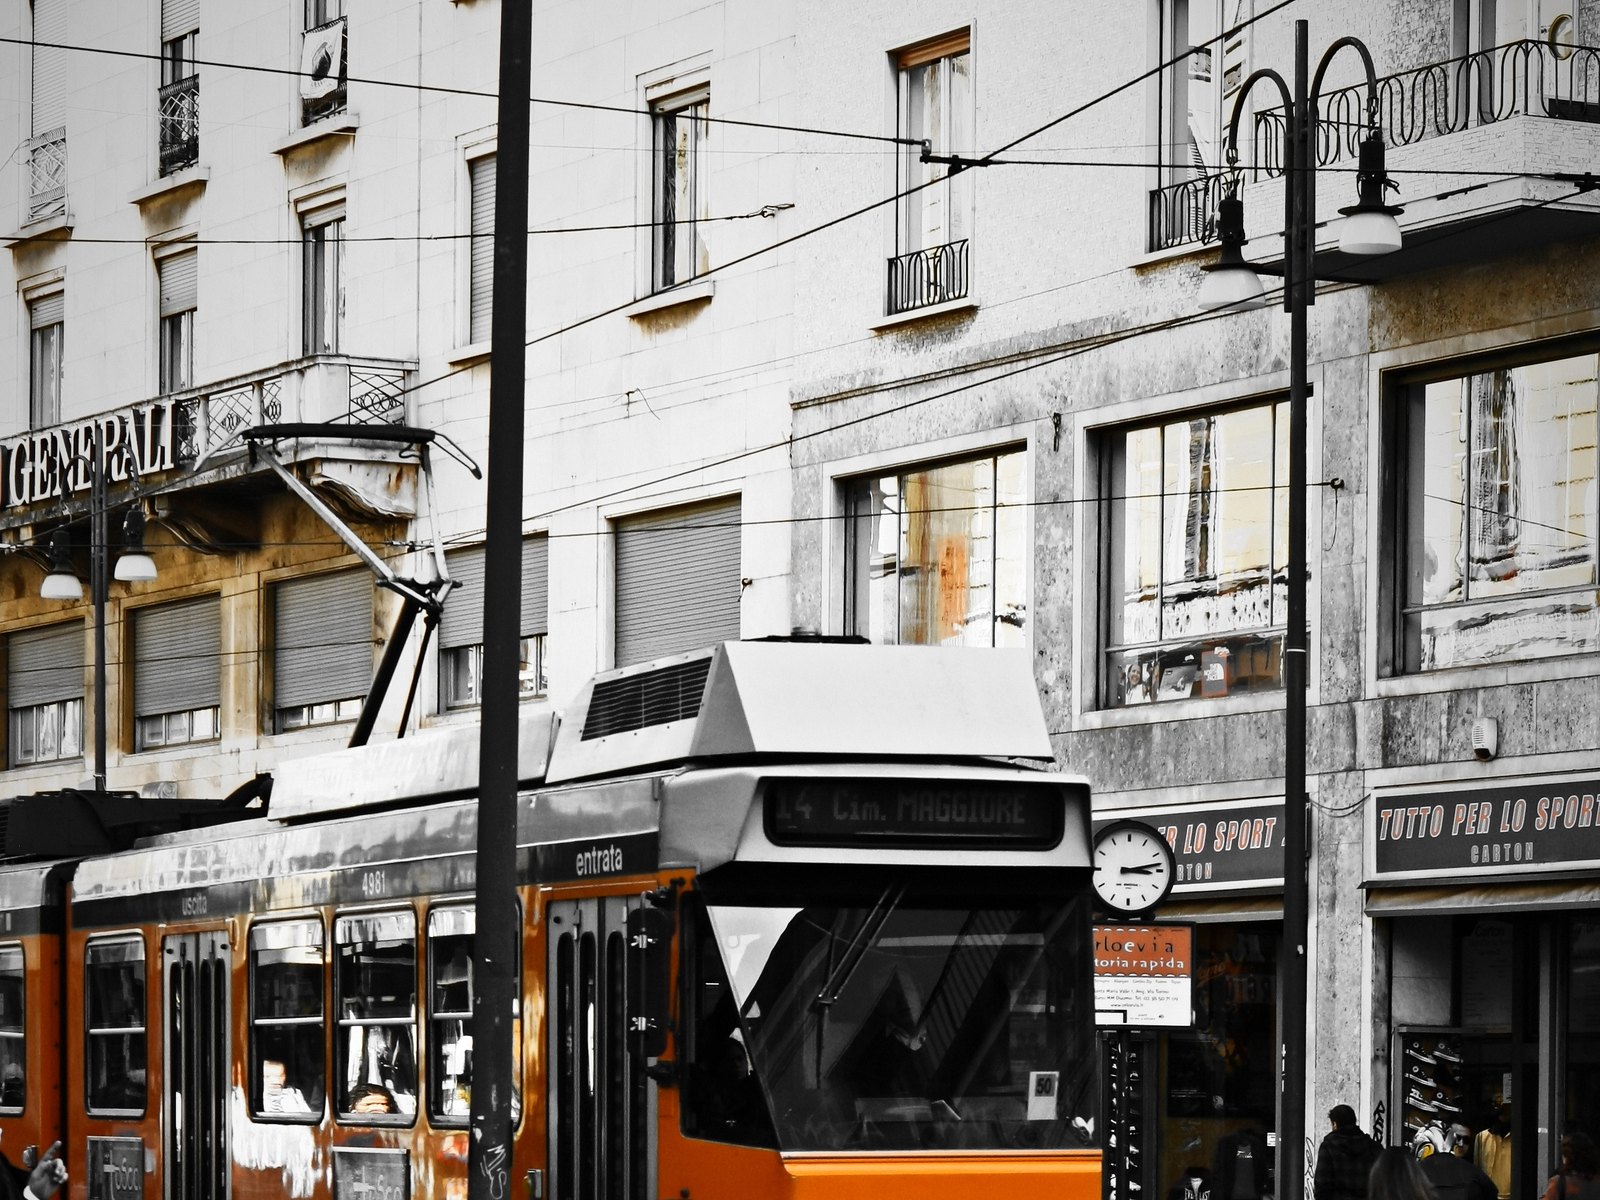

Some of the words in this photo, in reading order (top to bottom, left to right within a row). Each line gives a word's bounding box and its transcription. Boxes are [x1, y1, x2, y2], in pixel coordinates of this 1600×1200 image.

[9, 400, 176, 504] GENERALI
[1379, 804, 1444, 841] TUTTO
[1451, 801, 1493, 836] PER
[1500, 798, 1527, 833] LO
[1183, 822, 1207, 855] LO
[1213, 816, 1277, 853] SPORT
[575, 843, 623, 876] entrata
[1470, 841, 1534, 864] CARTON
[361, 870, 387, 897] 4981
[181, 893, 208, 916] uscita
[1036, 1077, 1052, 1094] 50
